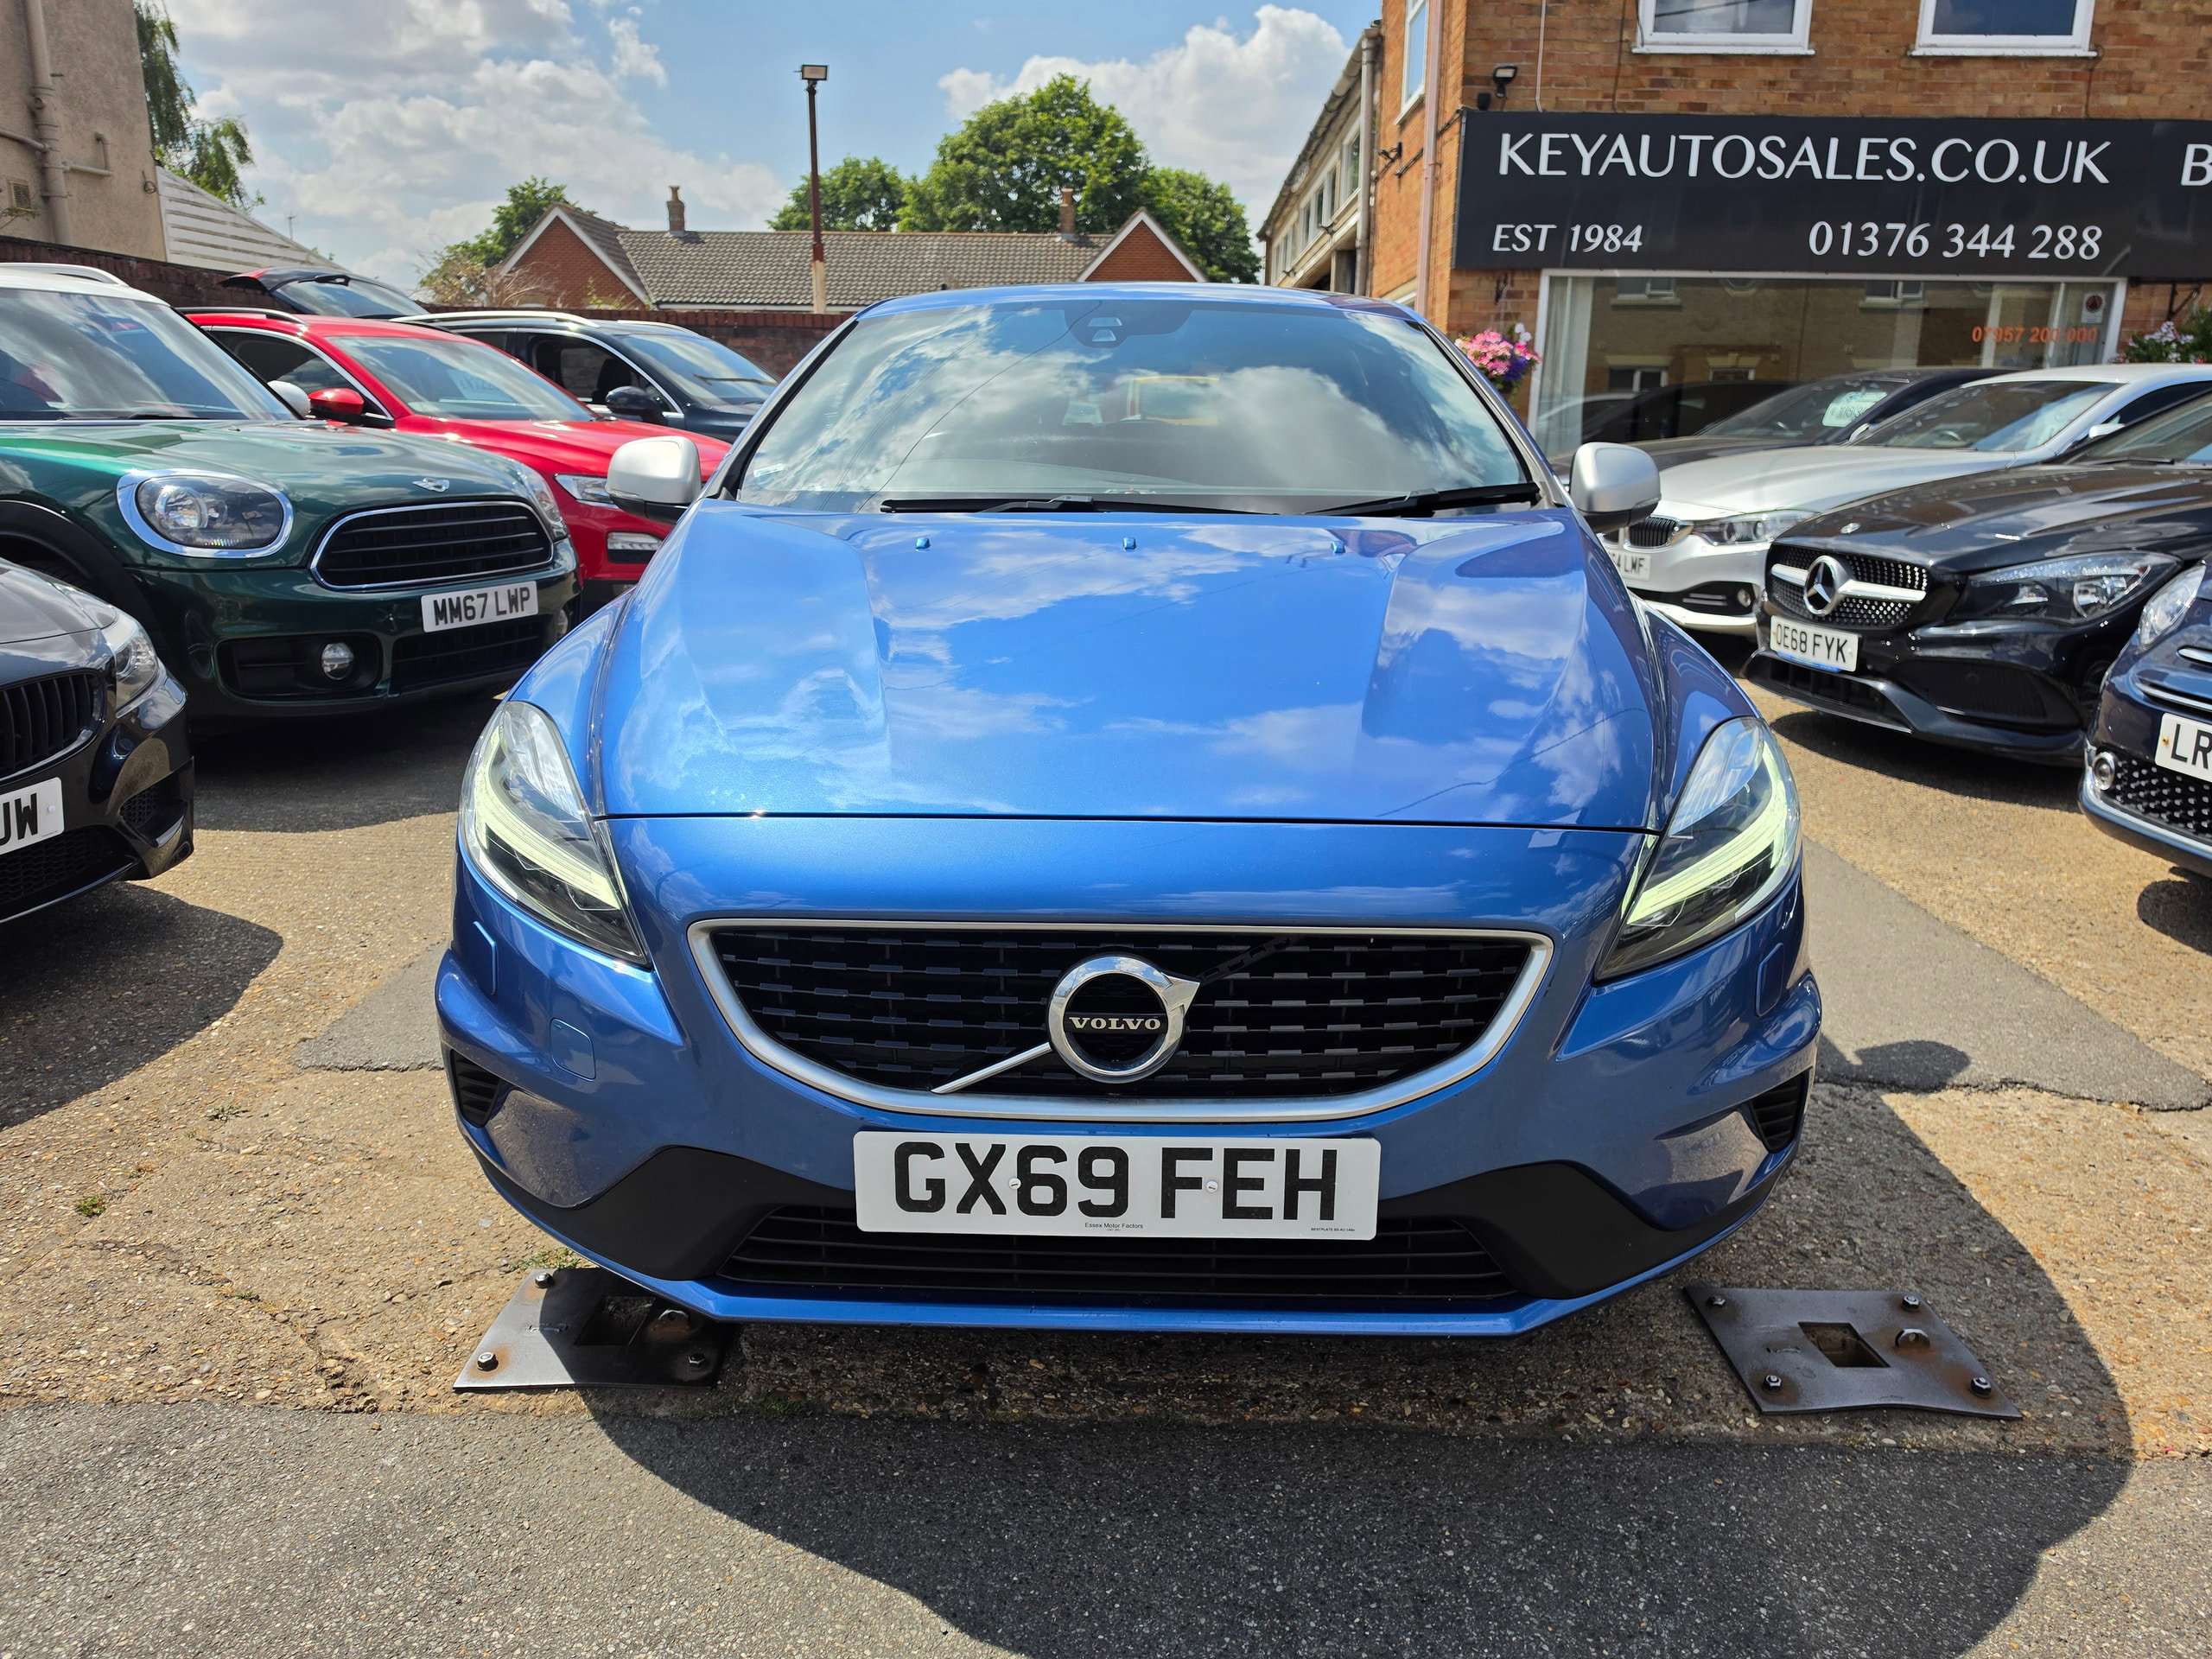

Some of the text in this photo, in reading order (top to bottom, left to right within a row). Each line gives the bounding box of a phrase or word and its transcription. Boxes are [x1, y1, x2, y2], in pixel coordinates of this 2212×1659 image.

[1499, 133, 2111, 184] KEYAUTOSALES.CO.UK
[1492, 223, 1643, 253] EST 1984
[1808, 220, 2102, 260] 01376 344 288
[1972, 326, 2099, 343] 07957 200 000
[433, 587, 531, 626] MM67 LWP
[1776, 624, 1847, 663] OE68 FYK
[1069, 1016, 1161, 1030] VOLVO
[893, 1141, 1338, 1221] GX69 FEH
